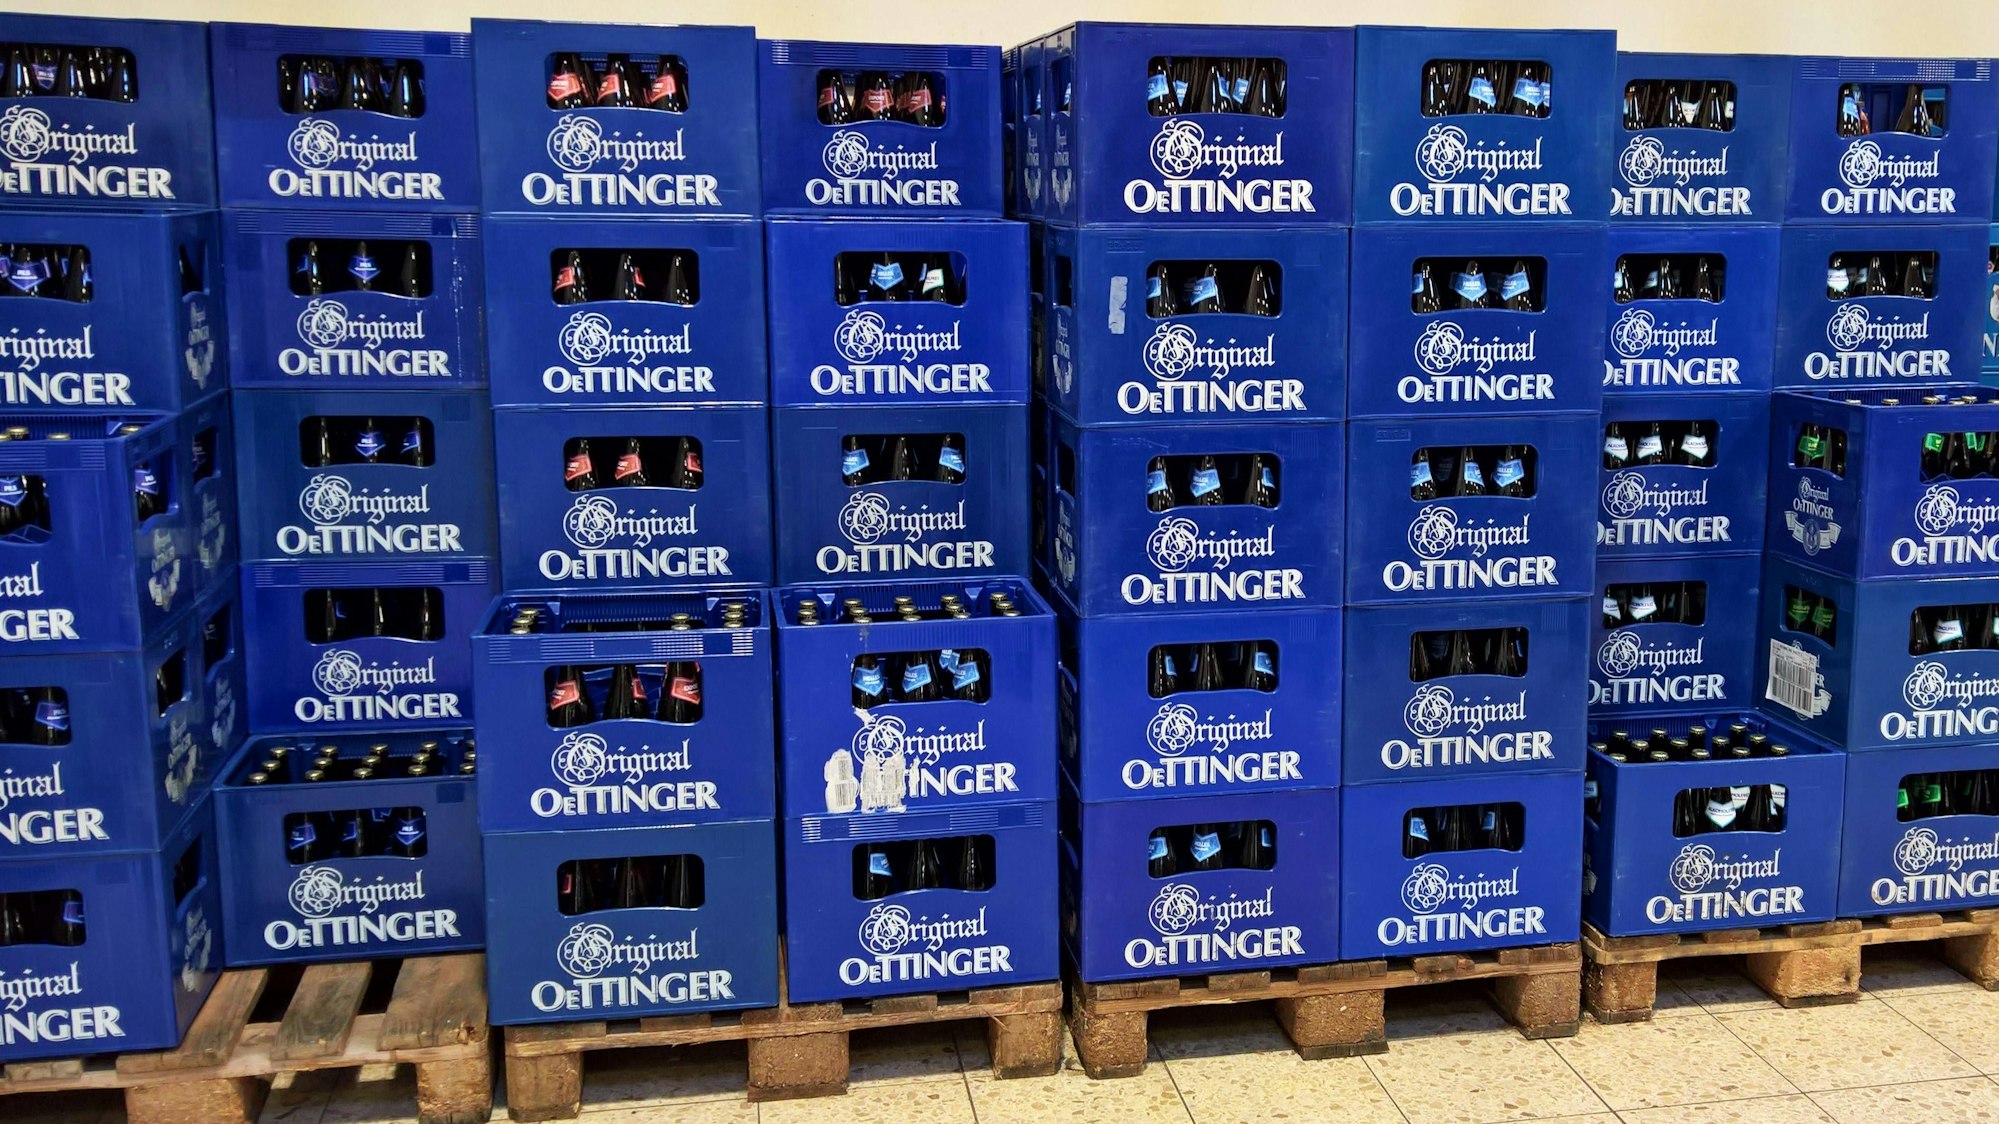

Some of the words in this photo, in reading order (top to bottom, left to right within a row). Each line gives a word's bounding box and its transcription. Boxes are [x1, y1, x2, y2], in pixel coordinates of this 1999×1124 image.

[0, 105, 137, 164] Original
[288, 117, 417, 171] Original
[547, 114, 686, 173] Original
[823, 130, 938, 180] Original
[1150, 118, 1284, 179] Original
[1416, 123, 1542, 183] Original
[1619, 135, 1728, 187] Original
[1839, 139, 1940, 188] Original
[297, 298, 425, 350] Original
[559, 311, 692, 366] Original
[834, 309, 961, 364] Original
[1415, 320, 1536, 375] Original
[1611, 308, 1718, 358] Original
[1827, 303, 1929, 351] Original
[1143, 322, 1275, 381] Original
[299, 474, 430, 525] Original
[839, 491, 966, 544] Original
[1602, 471, 1708, 518] Original
[563, 494, 698, 549] Original
[1147, 516, 1275, 572] Original
[1408, 505, 1530, 559] Original
[313, 649, 436, 697] Original
[1598, 630, 1703, 678] Original
[1147, 702, 1272, 756] Original
[1404, 684, 1526, 738] Original
[551, 731, 692, 788] Original
[852, 714, 986, 766] Original
[289, 866, 425, 919] Original
[1401, 863, 1519, 914] Original
[1670, 843, 1781, 894] Original
[859, 903, 987, 956] Original
[1149, 883, 1274, 935] Original
[557, 922, 699, 978] Original
